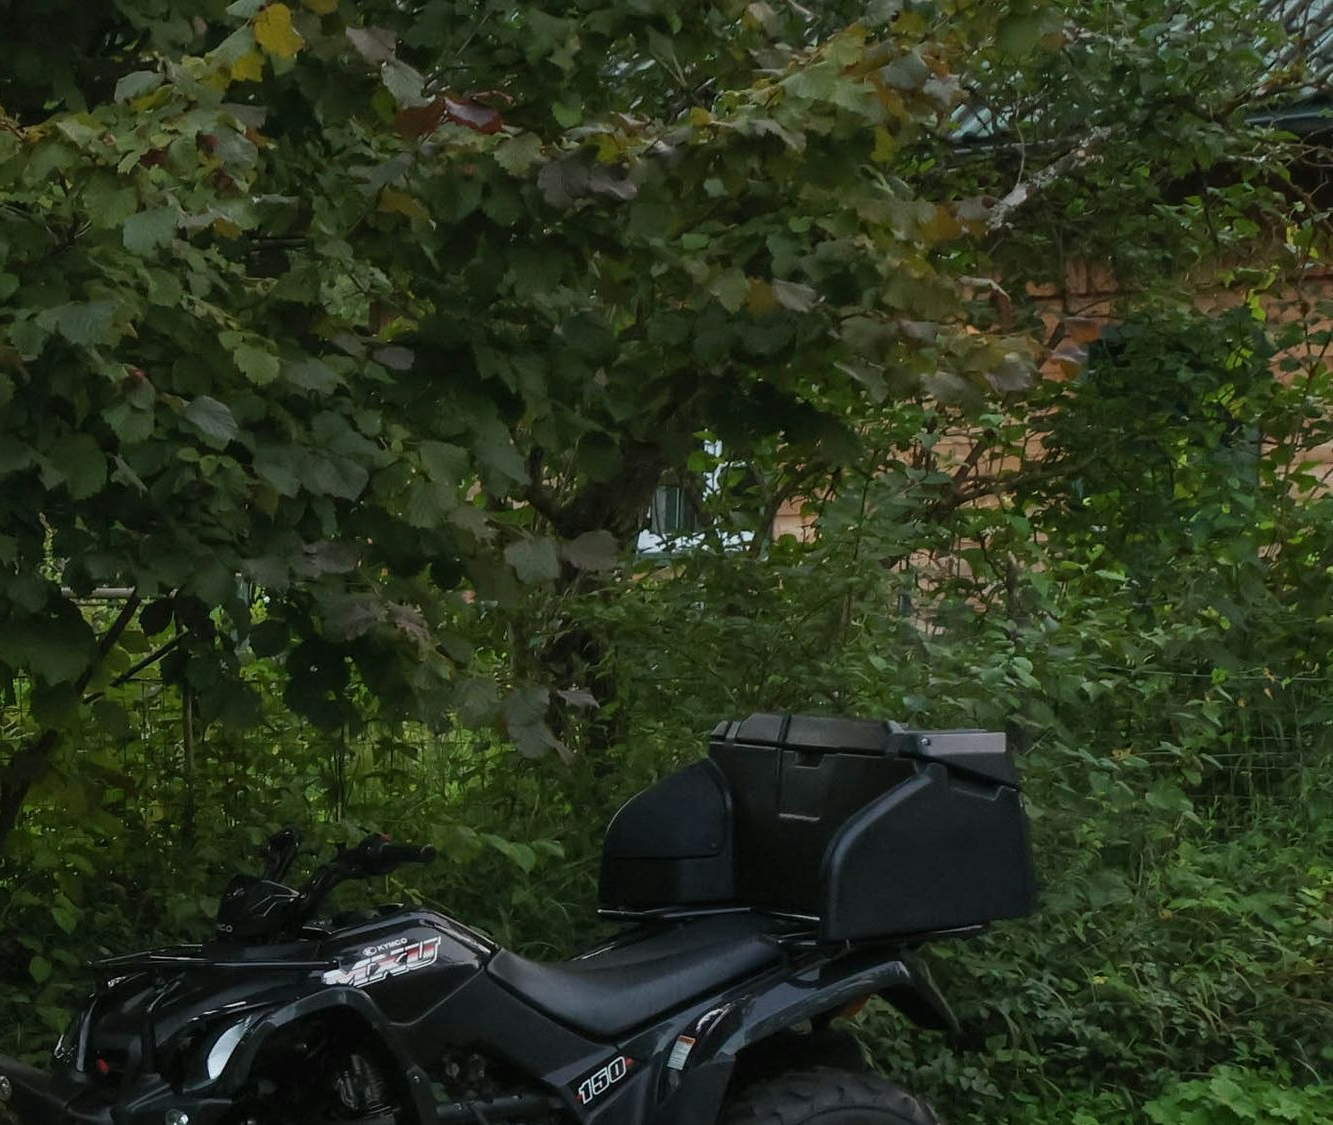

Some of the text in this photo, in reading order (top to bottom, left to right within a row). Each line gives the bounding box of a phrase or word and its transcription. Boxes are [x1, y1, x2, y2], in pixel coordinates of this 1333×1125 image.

[322, 936, 441, 988] MXU
[376, 937, 408, 952] KYMCO
[578, 1055, 627, 1105] 150
